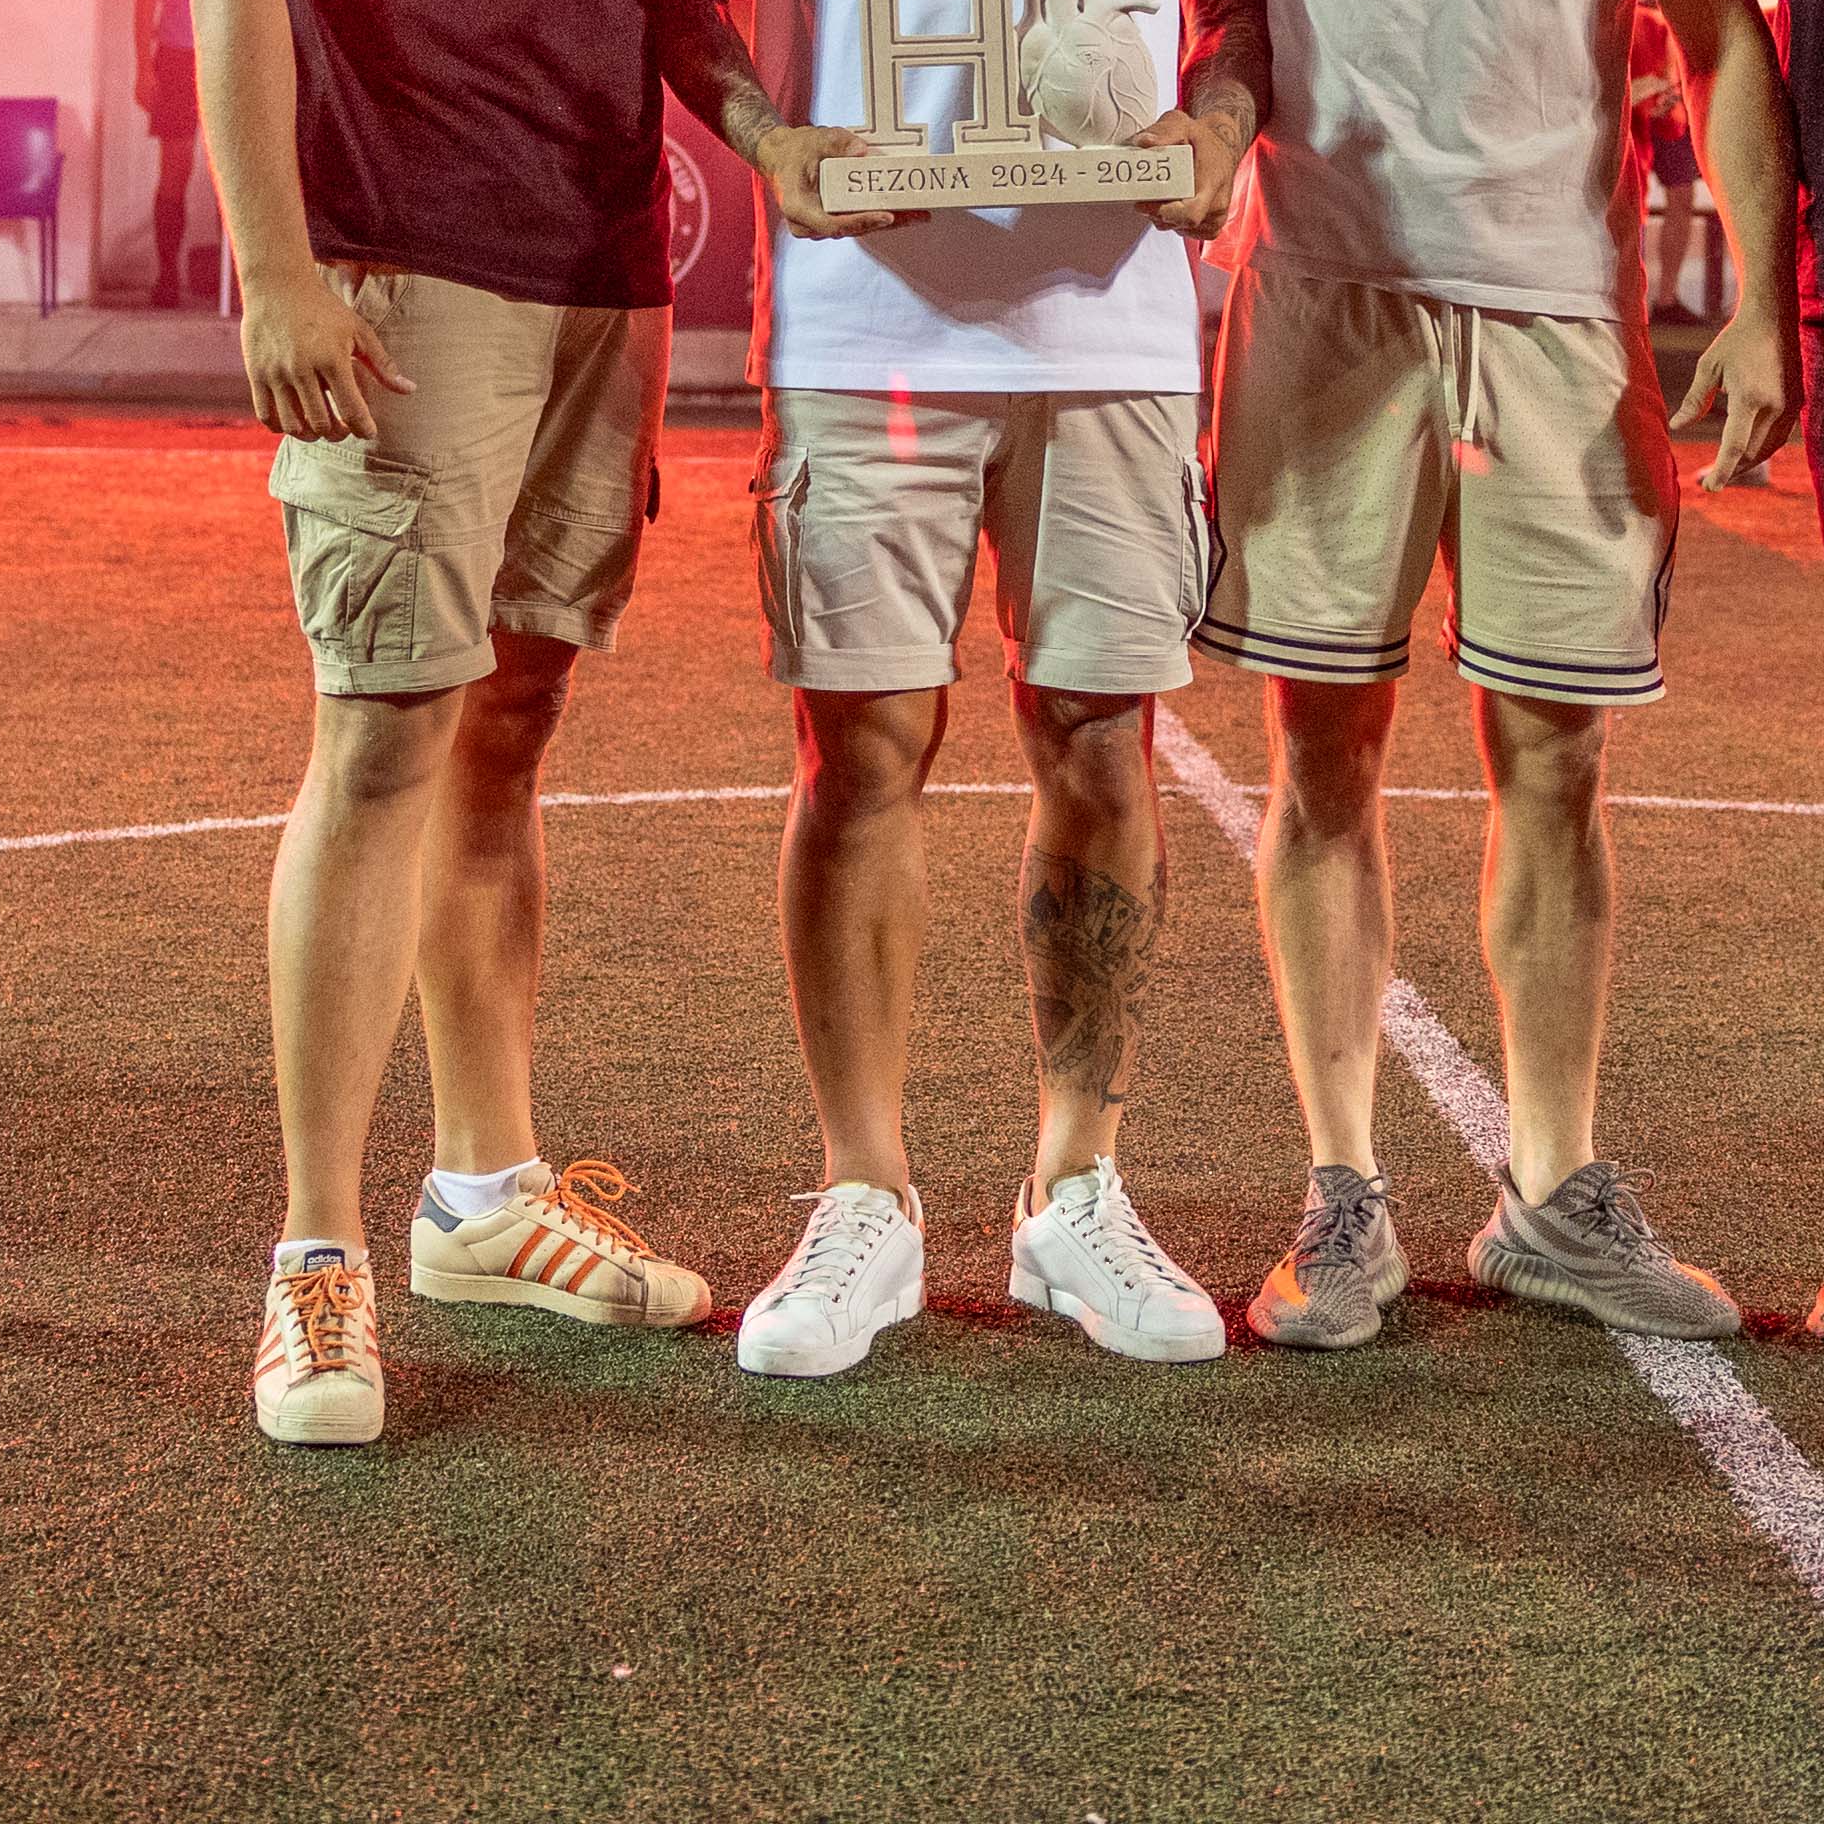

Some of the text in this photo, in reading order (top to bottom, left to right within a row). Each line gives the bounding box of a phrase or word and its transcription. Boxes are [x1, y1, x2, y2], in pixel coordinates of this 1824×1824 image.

[847, 166, 971, 194] SEZONA
[991, 162, 1068, 189] 2024
[1096, 155, 1173, 184] 2025
